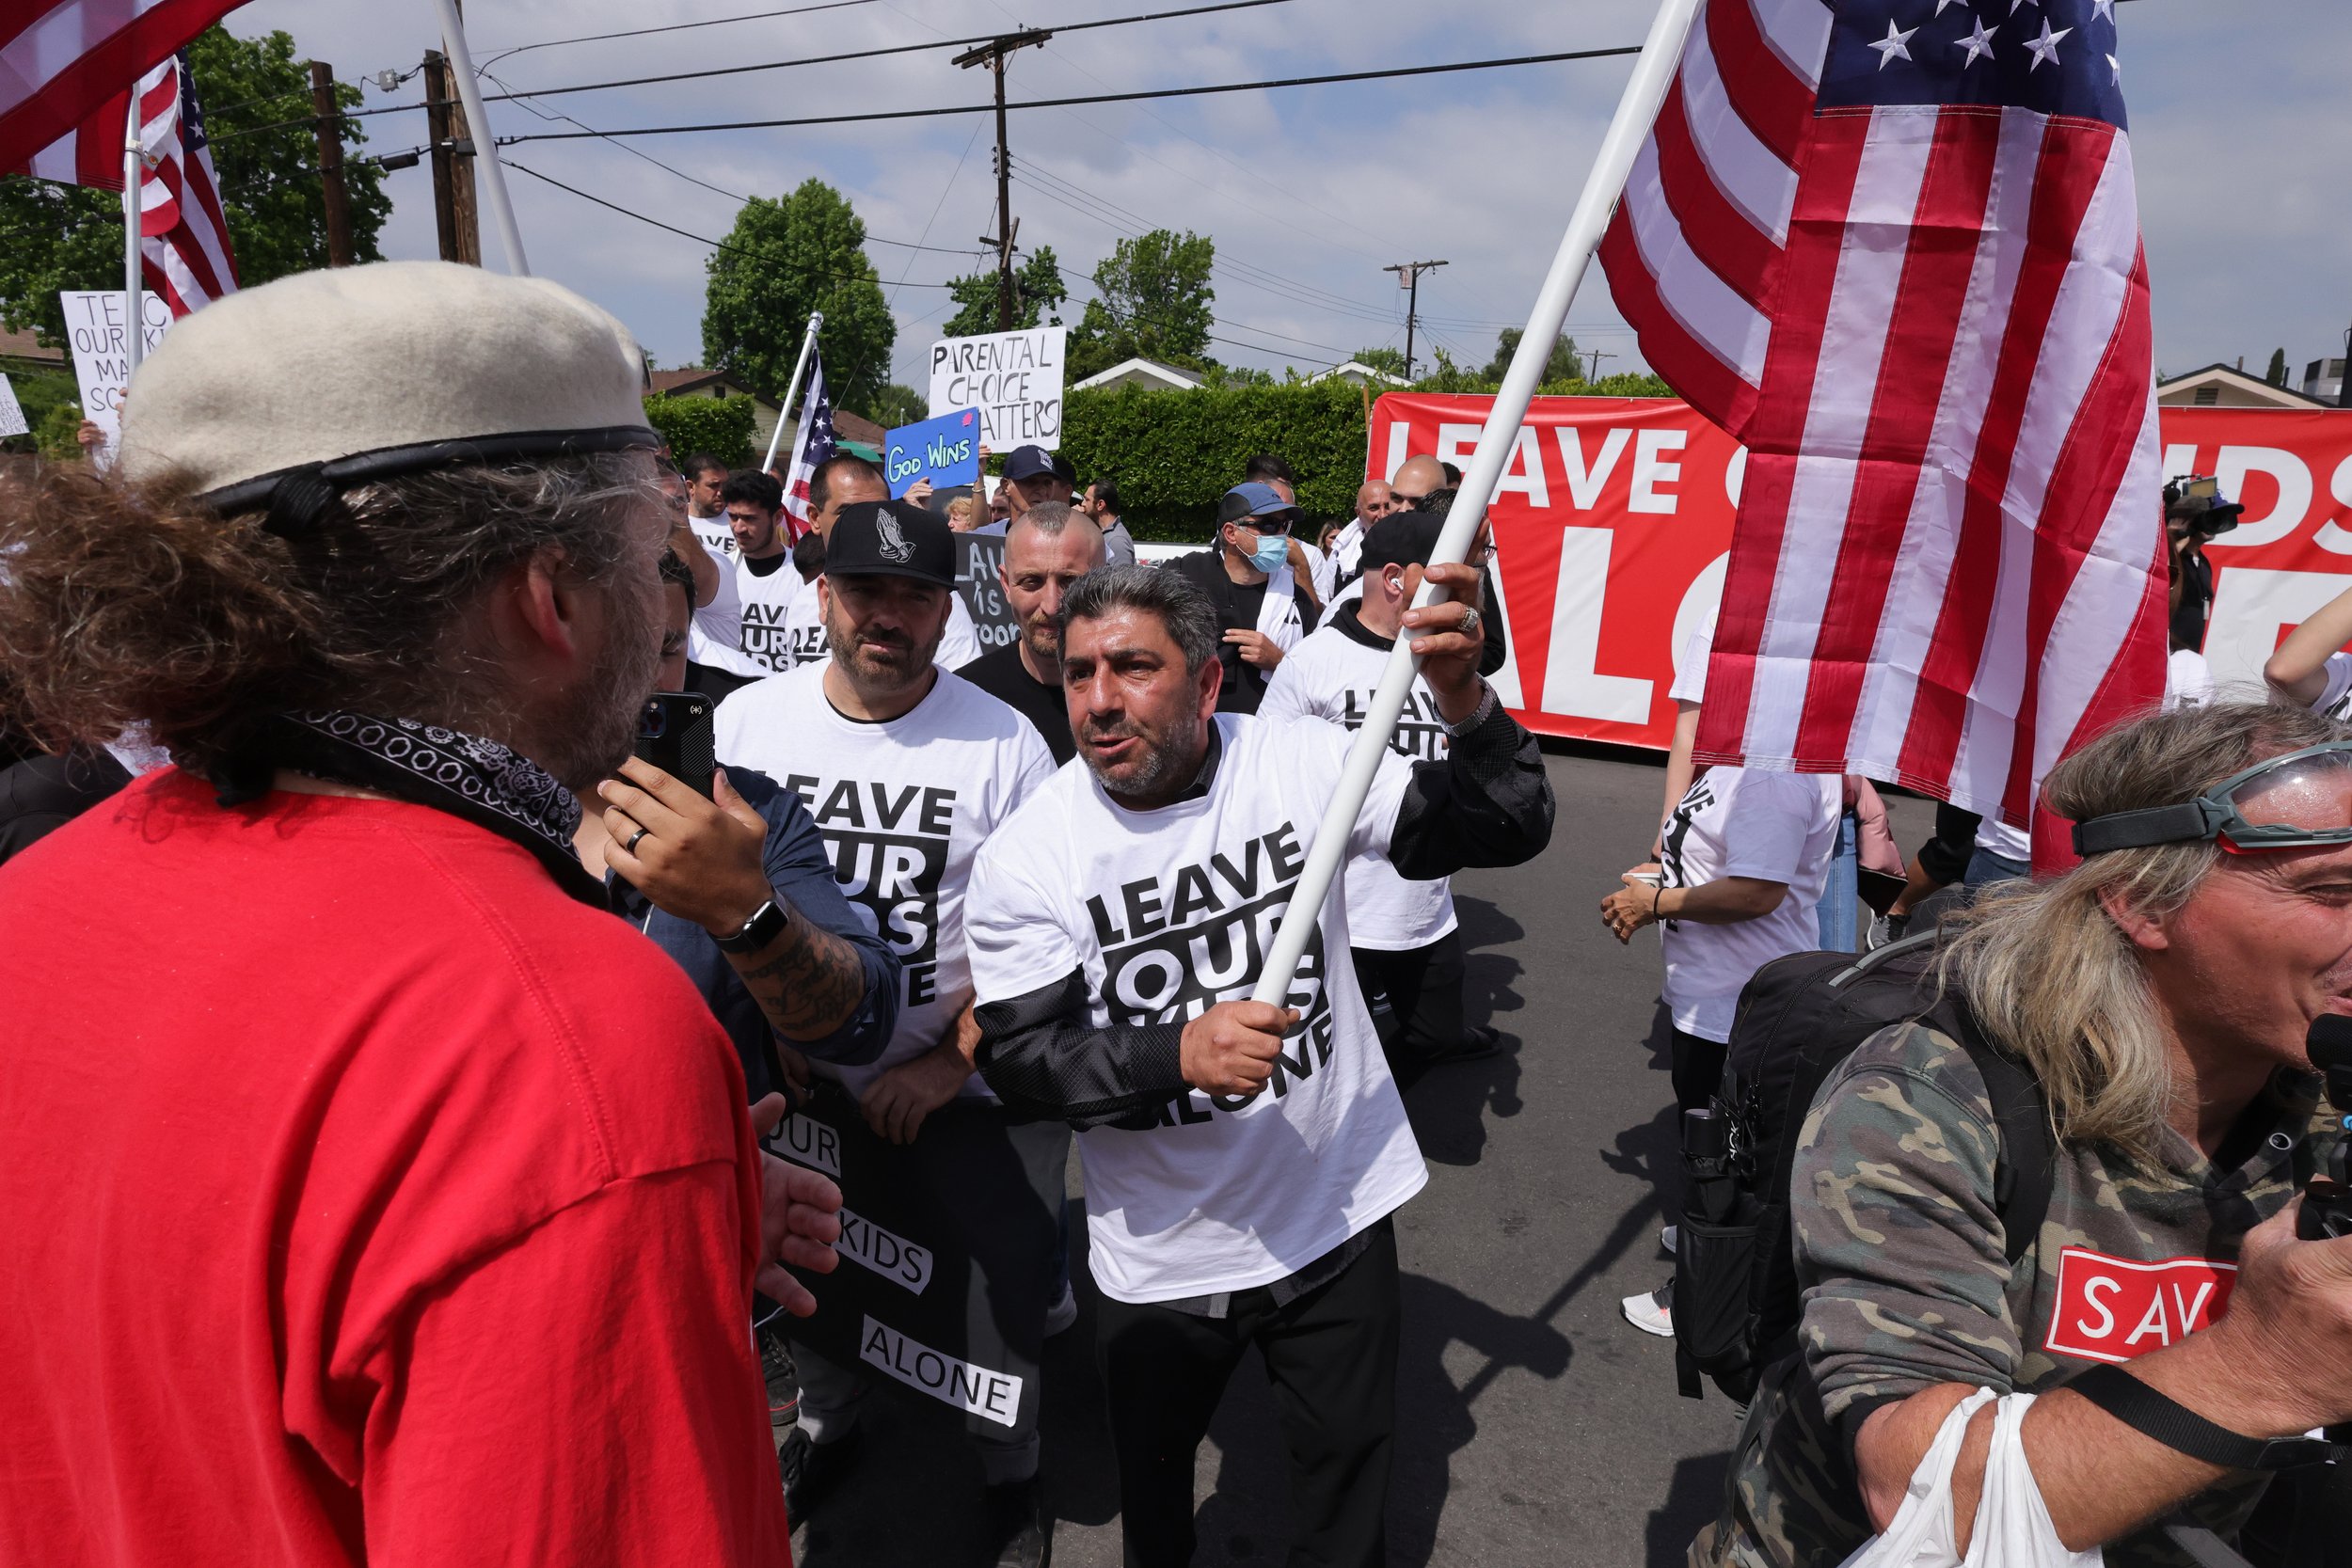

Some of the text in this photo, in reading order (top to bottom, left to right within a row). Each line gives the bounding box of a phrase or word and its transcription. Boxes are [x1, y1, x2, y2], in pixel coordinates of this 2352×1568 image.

[75, 327, 126, 354] OUR
[932, 334, 1052, 374] PARENTAL
[978, 399, 1060, 442] ATTERS!
[754, 770, 957, 836] EAVE
[823, 837, 927, 899] UR
[1086, 820, 1306, 948] LEAVE
[837, 1211, 924, 1284] KIDS
[2076, 1275, 2214, 1347] SAV
[864, 1325, 1012, 1417] ALONE
